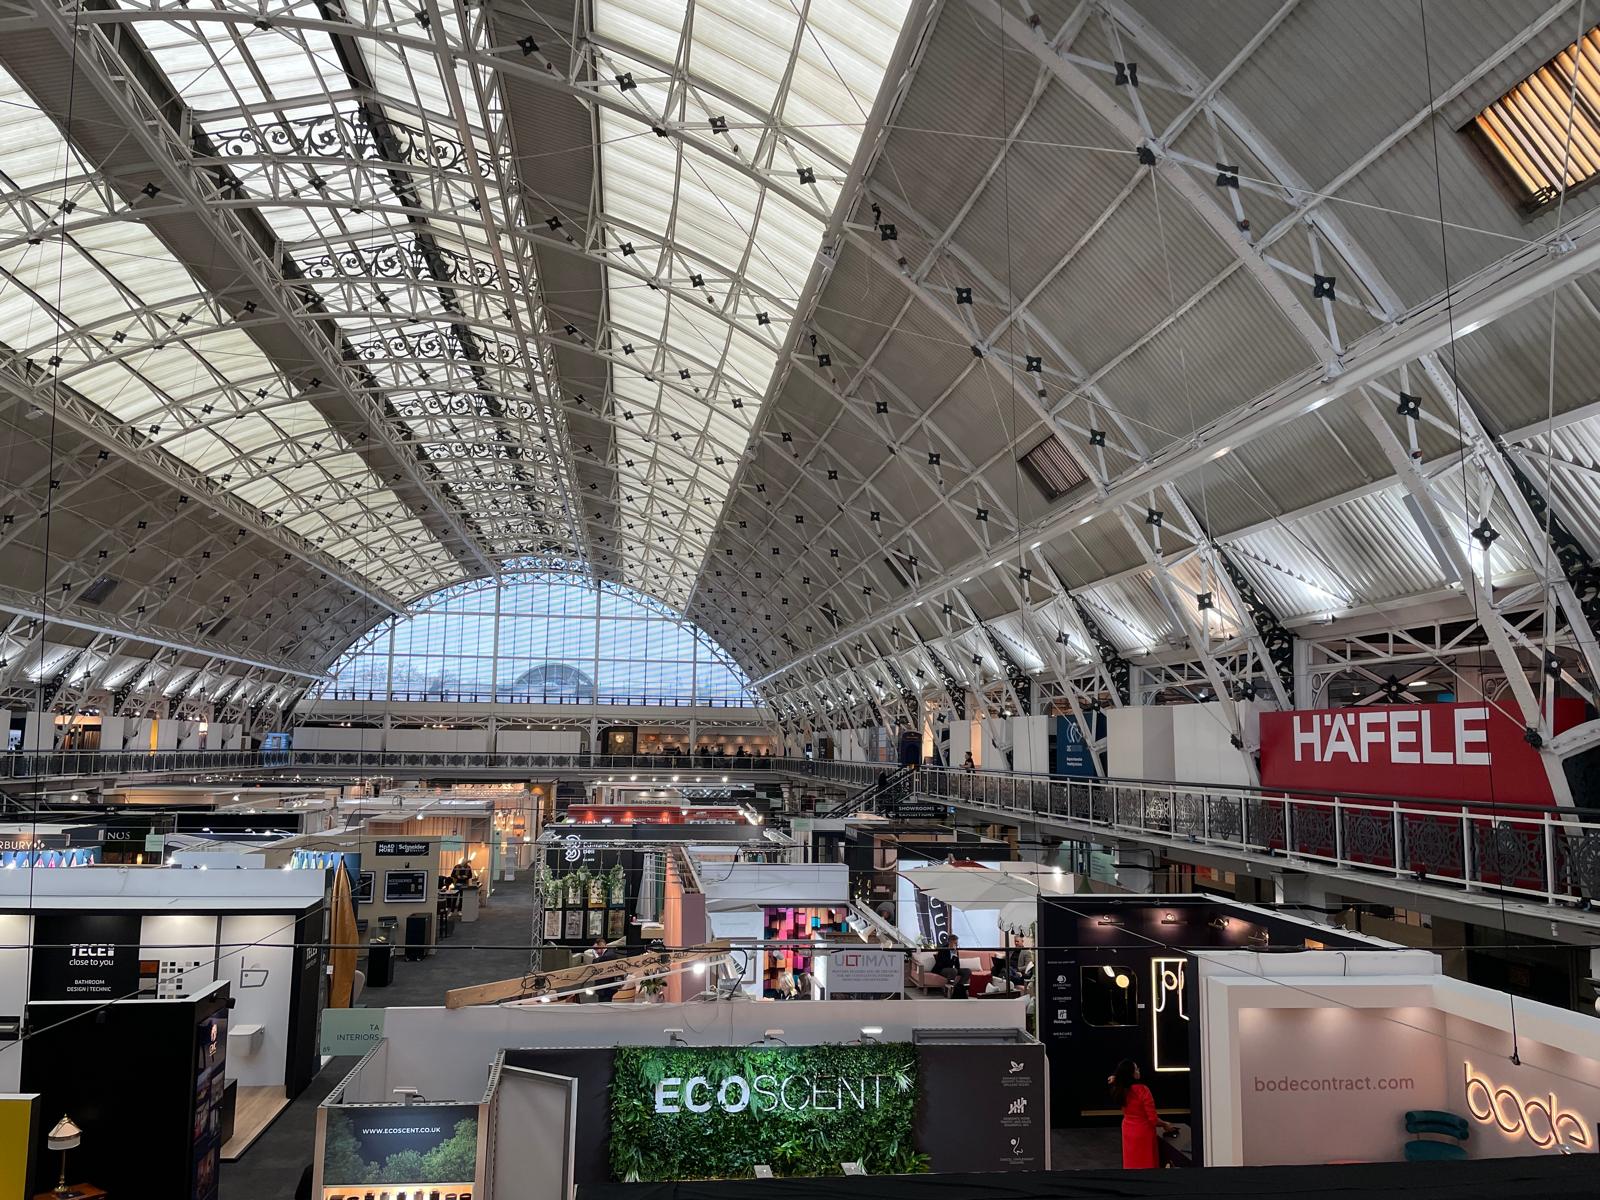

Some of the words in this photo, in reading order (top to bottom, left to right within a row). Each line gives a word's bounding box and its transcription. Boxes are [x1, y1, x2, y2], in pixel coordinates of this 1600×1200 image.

[1293, 707, 1492, 766] HÄFELE
[70, 943, 107, 957] TECE
[99, 960, 114, 968] you
[336, 1033, 380, 1041] INTERIORS
[1254, 1075, 1415, 1093] bodecontract.com
[655, 1075, 890, 1113] ECOSCENT
